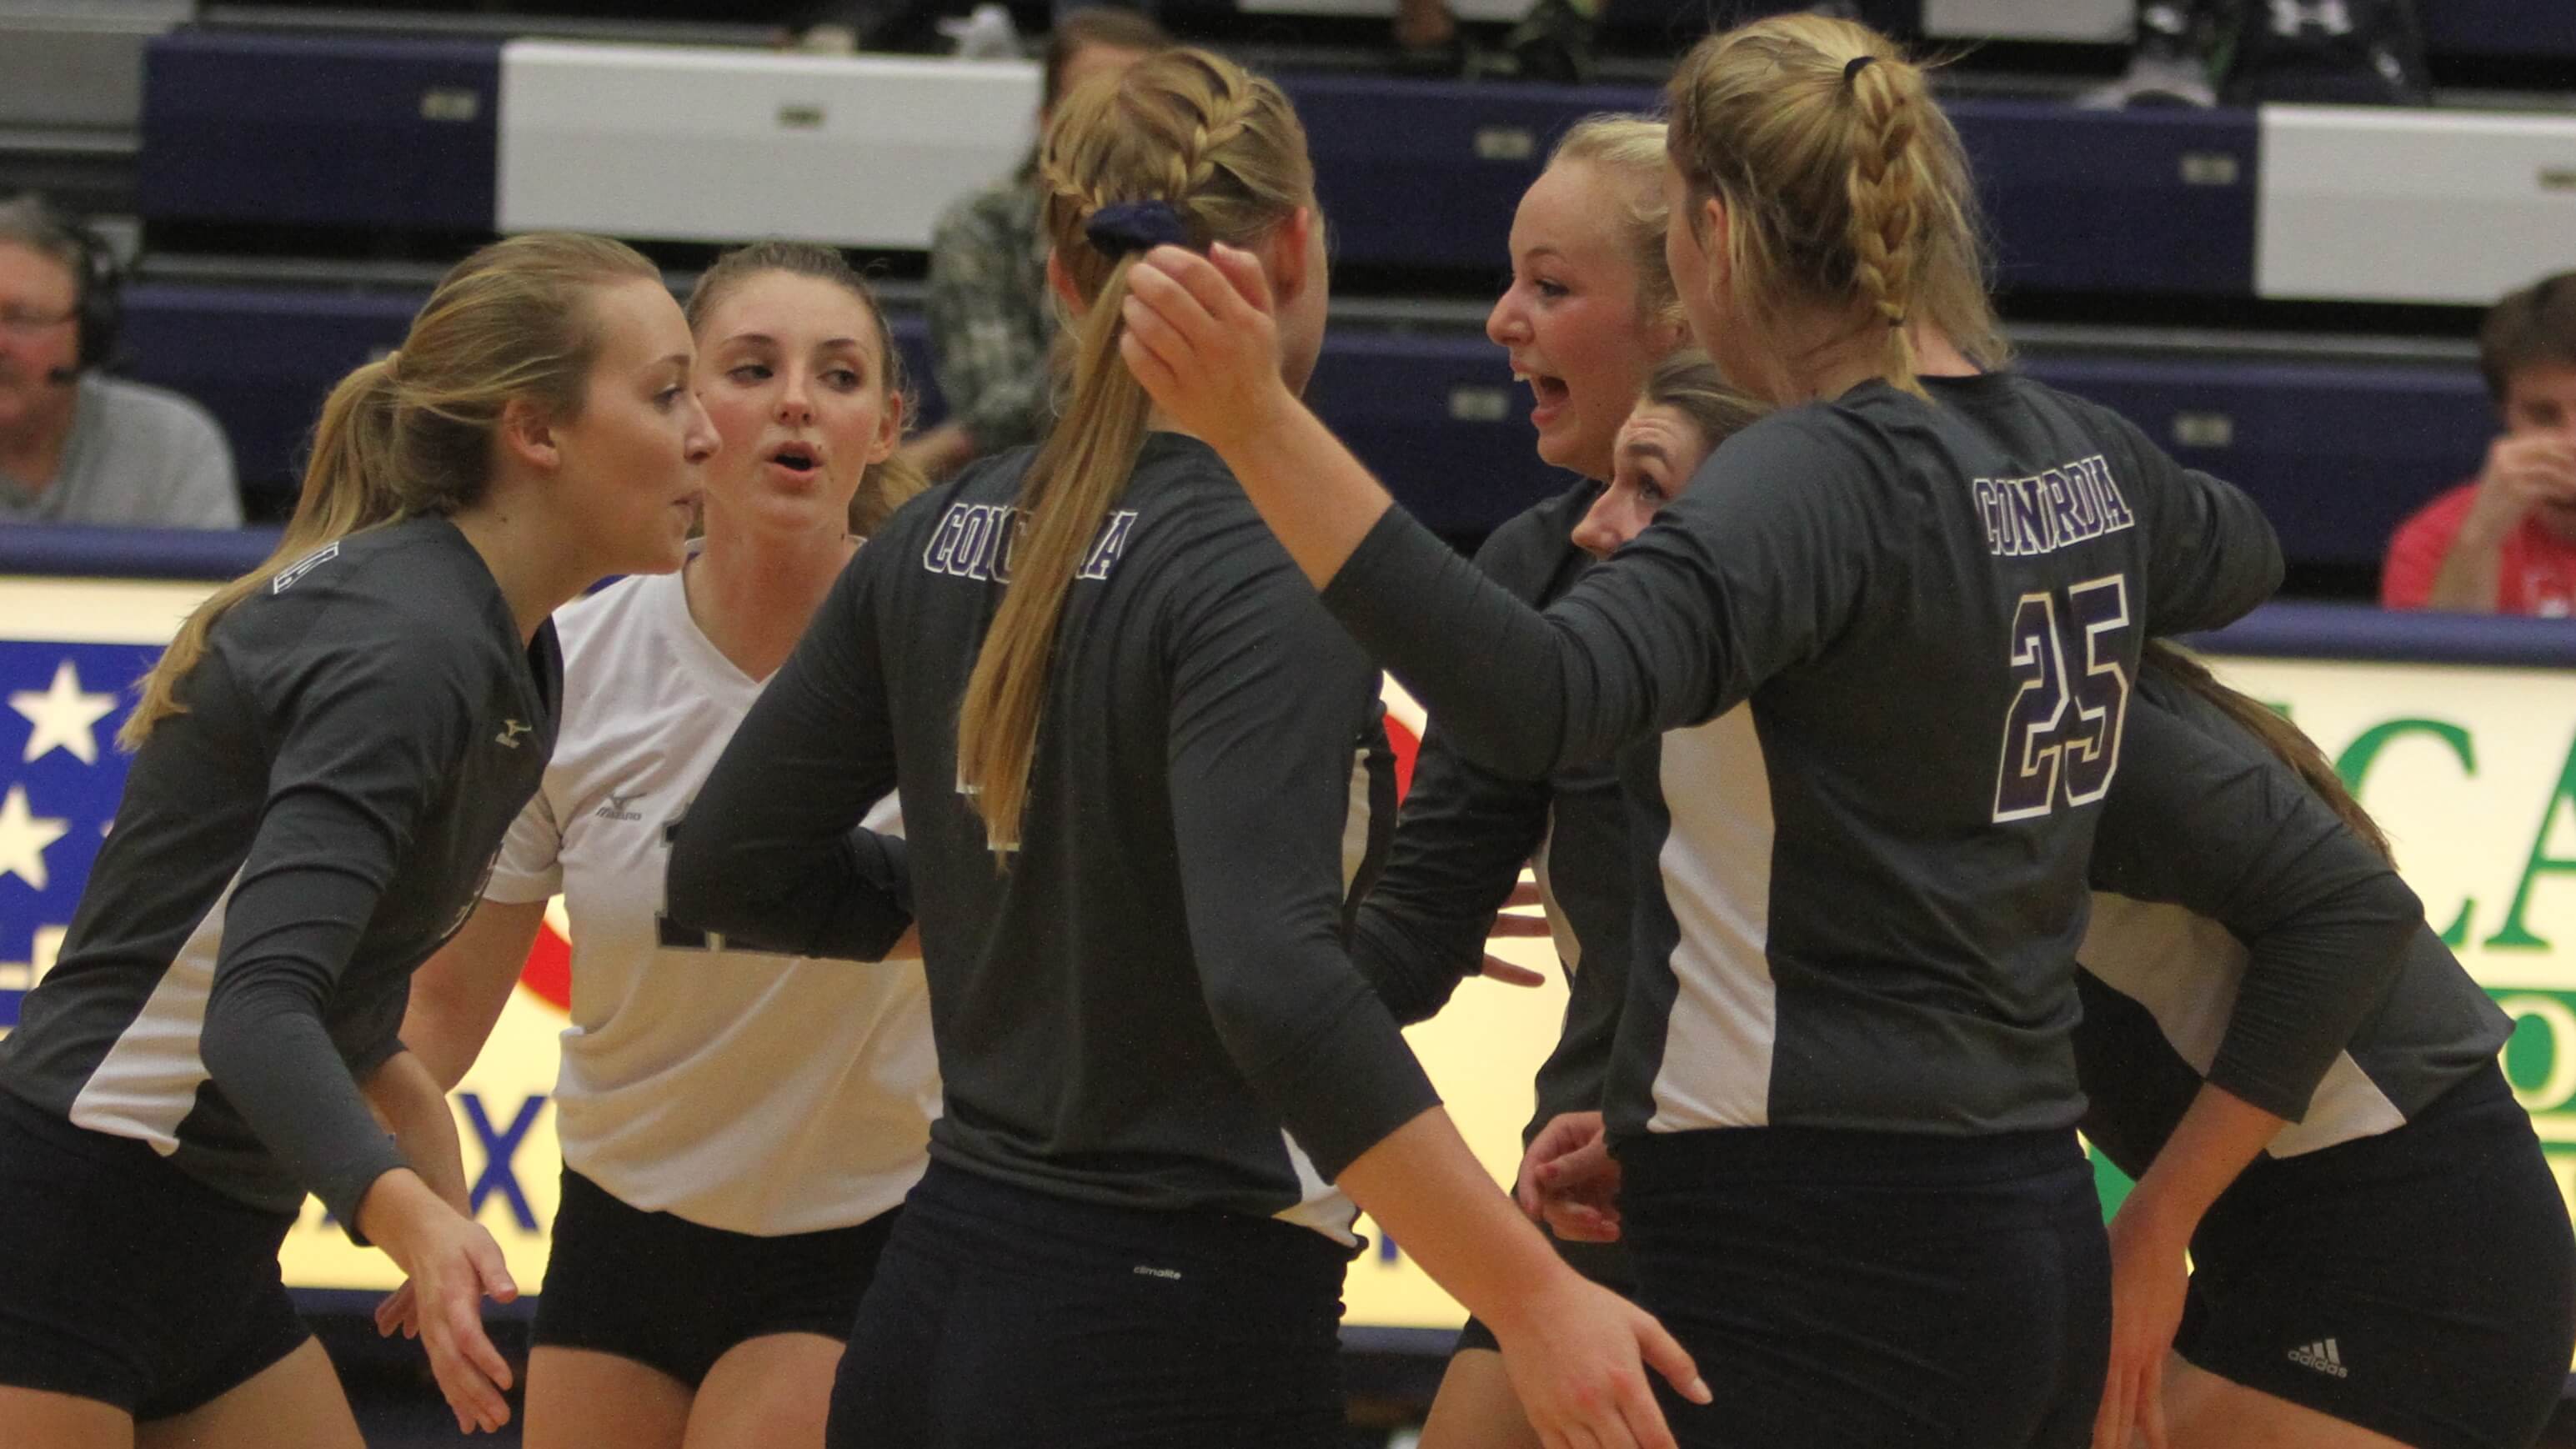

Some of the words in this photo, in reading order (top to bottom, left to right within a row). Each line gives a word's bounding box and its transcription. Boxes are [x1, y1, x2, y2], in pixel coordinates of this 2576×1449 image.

[1992, 573, 2129, 823] 25
[1134, 1266, 1181, 1280] climalite
[2287, 1350, 2348, 1378] adidas
